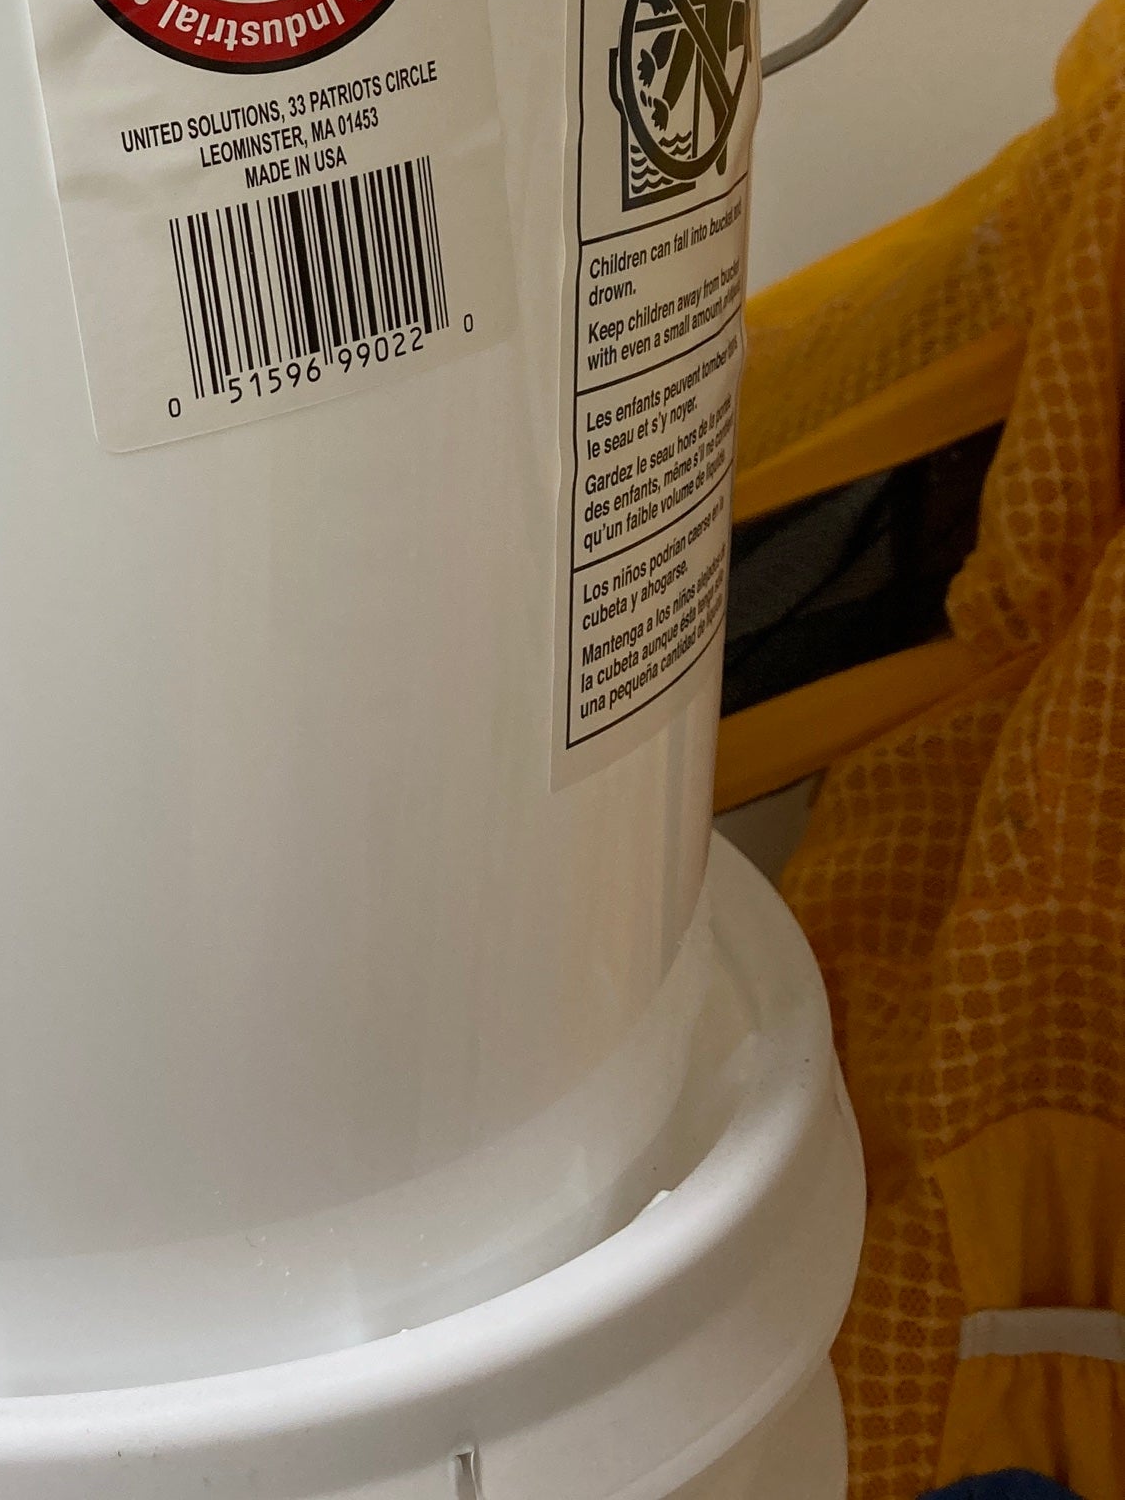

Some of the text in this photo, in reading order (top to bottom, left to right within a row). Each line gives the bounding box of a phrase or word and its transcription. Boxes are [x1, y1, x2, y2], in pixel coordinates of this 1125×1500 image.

[121, 60, 438, 153] UNITED SOLUTIONS, 33 PATRIOTS CIRCLE
[200, 107, 379, 168] LEOMINSTER, MA 01453
[245, 146, 347, 188] MADE IN USA
[589, 250, 647, 279] Children
[650, 241, 671, 261] can
[674, 228, 689, 253] fall
[690, 223, 707, 246] into
[588, 321, 624, 345] Keep
[628, 299, 675, 332] children
[677, 289, 702, 310] away
[589, 280, 636, 307] drown.
[168, 313, 474, 418] 0 51596 99022 0
[588, 297, 723, 371] with even a small amount
[586, 411, 612, 432] Les
[616, 389, 661, 422] enfants
[663, 367, 700, 406] peuvent
[587, 440, 600, 460] le
[604, 431, 634, 453] seau
[637, 419, 649, 439] et
[670, 396, 697, 424] noyer.
[585, 465, 633, 495] Gardez
[637, 456, 647, 476] le
[650, 447, 674, 469] seau
[678, 430, 696, 454] hors
[699, 421, 708, 440] de
[585, 502, 609, 522] des
[614, 478, 661, 511] enfants,
[664, 458, 691, 486] même
[584, 523, 622, 552] qu'un
[626, 504, 658, 531] faible
[661, 480, 694, 513] volume
[695, 470, 705, 490] de
[583, 580, 608, 604] Los
[613, 560, 646, 591] niños
[583, 596, 627, 630] cubeta
[630, 591, 638, 613] y
[641, 560, 688, 602] ahogarse.
[582, 623, 643, 666] Mantenga
[646, 617, 652, 631] a
[655, 604, 670, 627] los
[673, 583, 695, 614] niños
[580, 698, 605, 719] una
[609, 662, 658, 710] pequeña
[581, 672, 593, 693] la
[597, 651, 639, 685] cubeta
[642, 624, 678, 661] aunque
